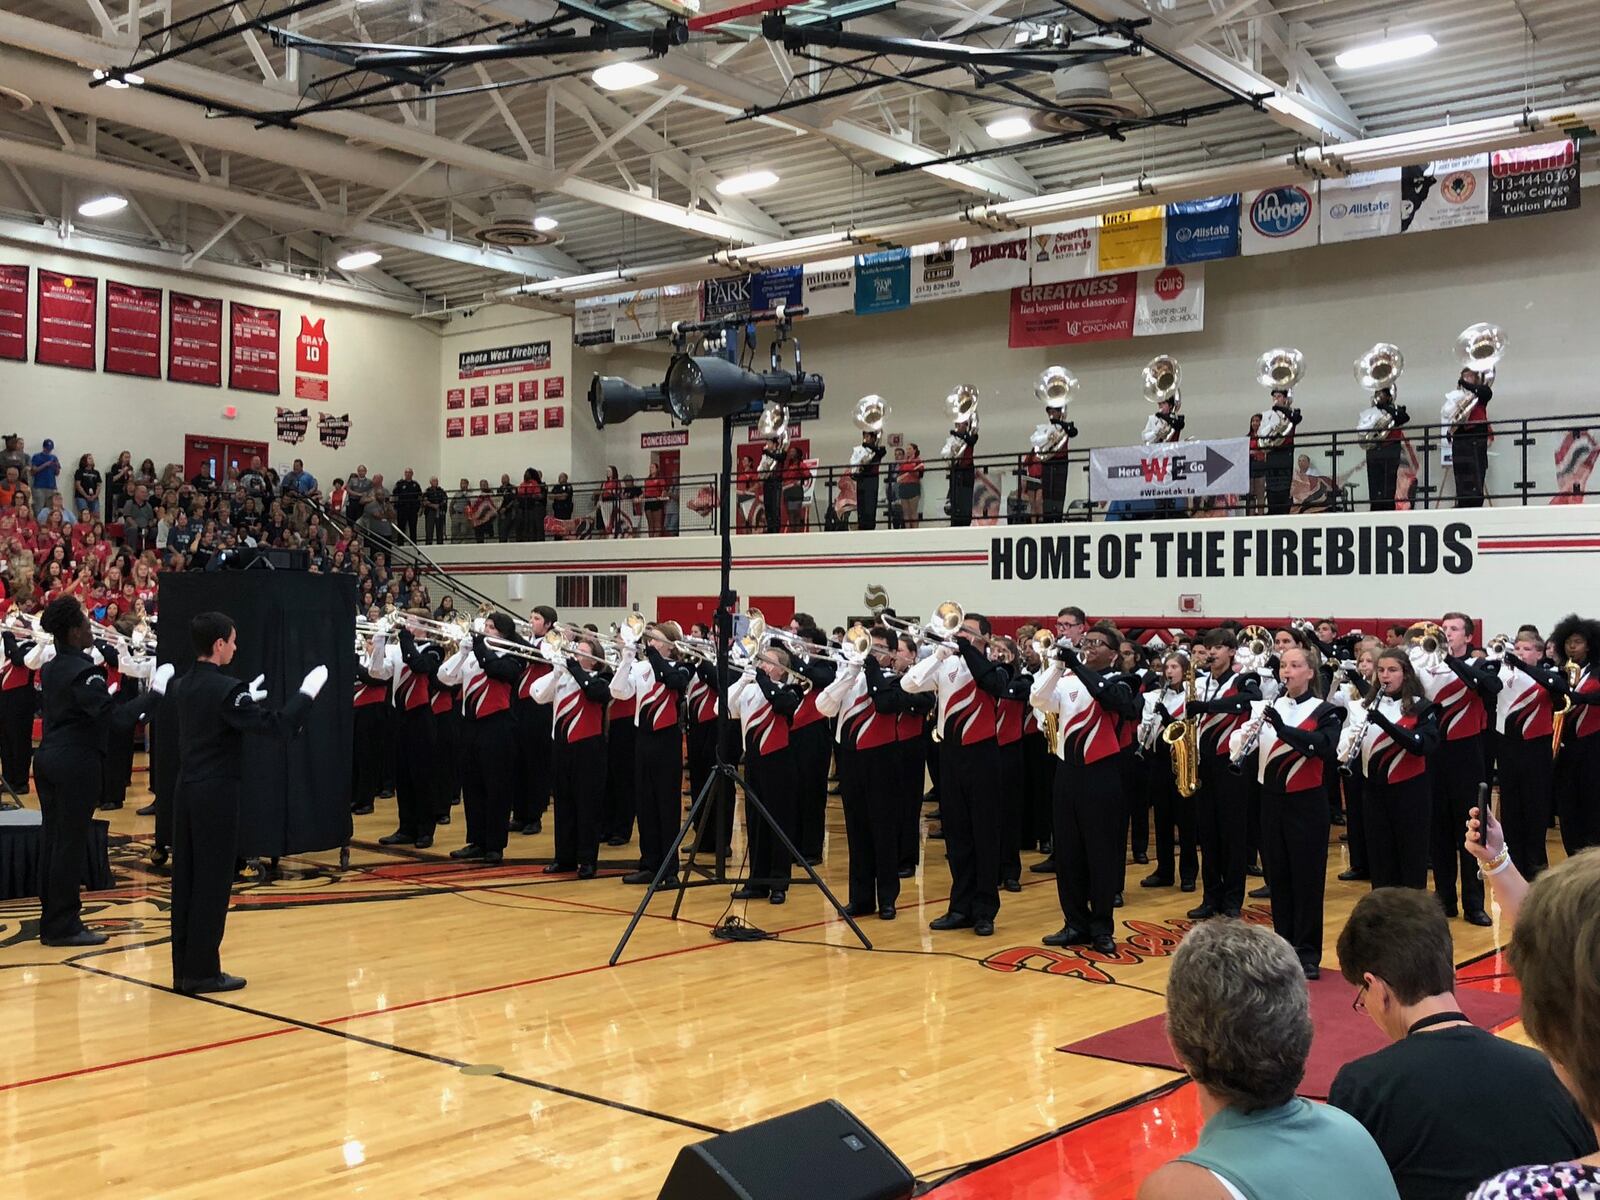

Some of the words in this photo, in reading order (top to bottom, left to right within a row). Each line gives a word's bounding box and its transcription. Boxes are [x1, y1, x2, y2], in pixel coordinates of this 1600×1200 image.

[1491, 168, 1577, 192] 513-444-0369
[1501, 189, 1526, 201] 100%
[1529, 184, 1570, 199] College
[1256, 192, 1307, 231] Kroger
[1349, 200, 1390, 216] Allstate
[1502, 201, 1540, 214] Tuition
[1544, 196, 1567, 209] Paid
[1056, 227, 1088, 242] Scott's
[1192, 224, 1229, 239] Allstate
[1052, 239, 1092, 254] Awards
[806, 267, 852, 286] milano's
[1157, 276, 1183, 292] TOM'S
[707, 279, 751, 305] PARK
[1020, 277, 1118, 302] GREATNESS
[1020, 304, 1035, 314] lies
[1036, 301, 1064, 315] beyond
[1066, 299, 1080, 310] the
[1081, 296, 1128, 308] classroom.
[1082, 320, 1128, 334] CINCINNATI
[301, 334, 324, 346] GRAY
[306, 345, 320, 362] 10
[461, 352, 488, 365] Lakota
[490, 349, 510, 361] West
[512, 343, 548, 359] Firebirds
[642, 433, 686, 447] CONCESSIONS
[1118, 466, 1141, 477] Here
[1141, 455, 1187, 483] WE
[1190, 461, 1204, 472] Go
[1140, 486, 1196, 497] #WEareLakta
[991, 535, 1091, 580] HOME
[1099, 533, 1143, 579] OF
[1151, 531, 1225, 578] THE
[1233, 522, 1474, 577] FIREBIRDS
